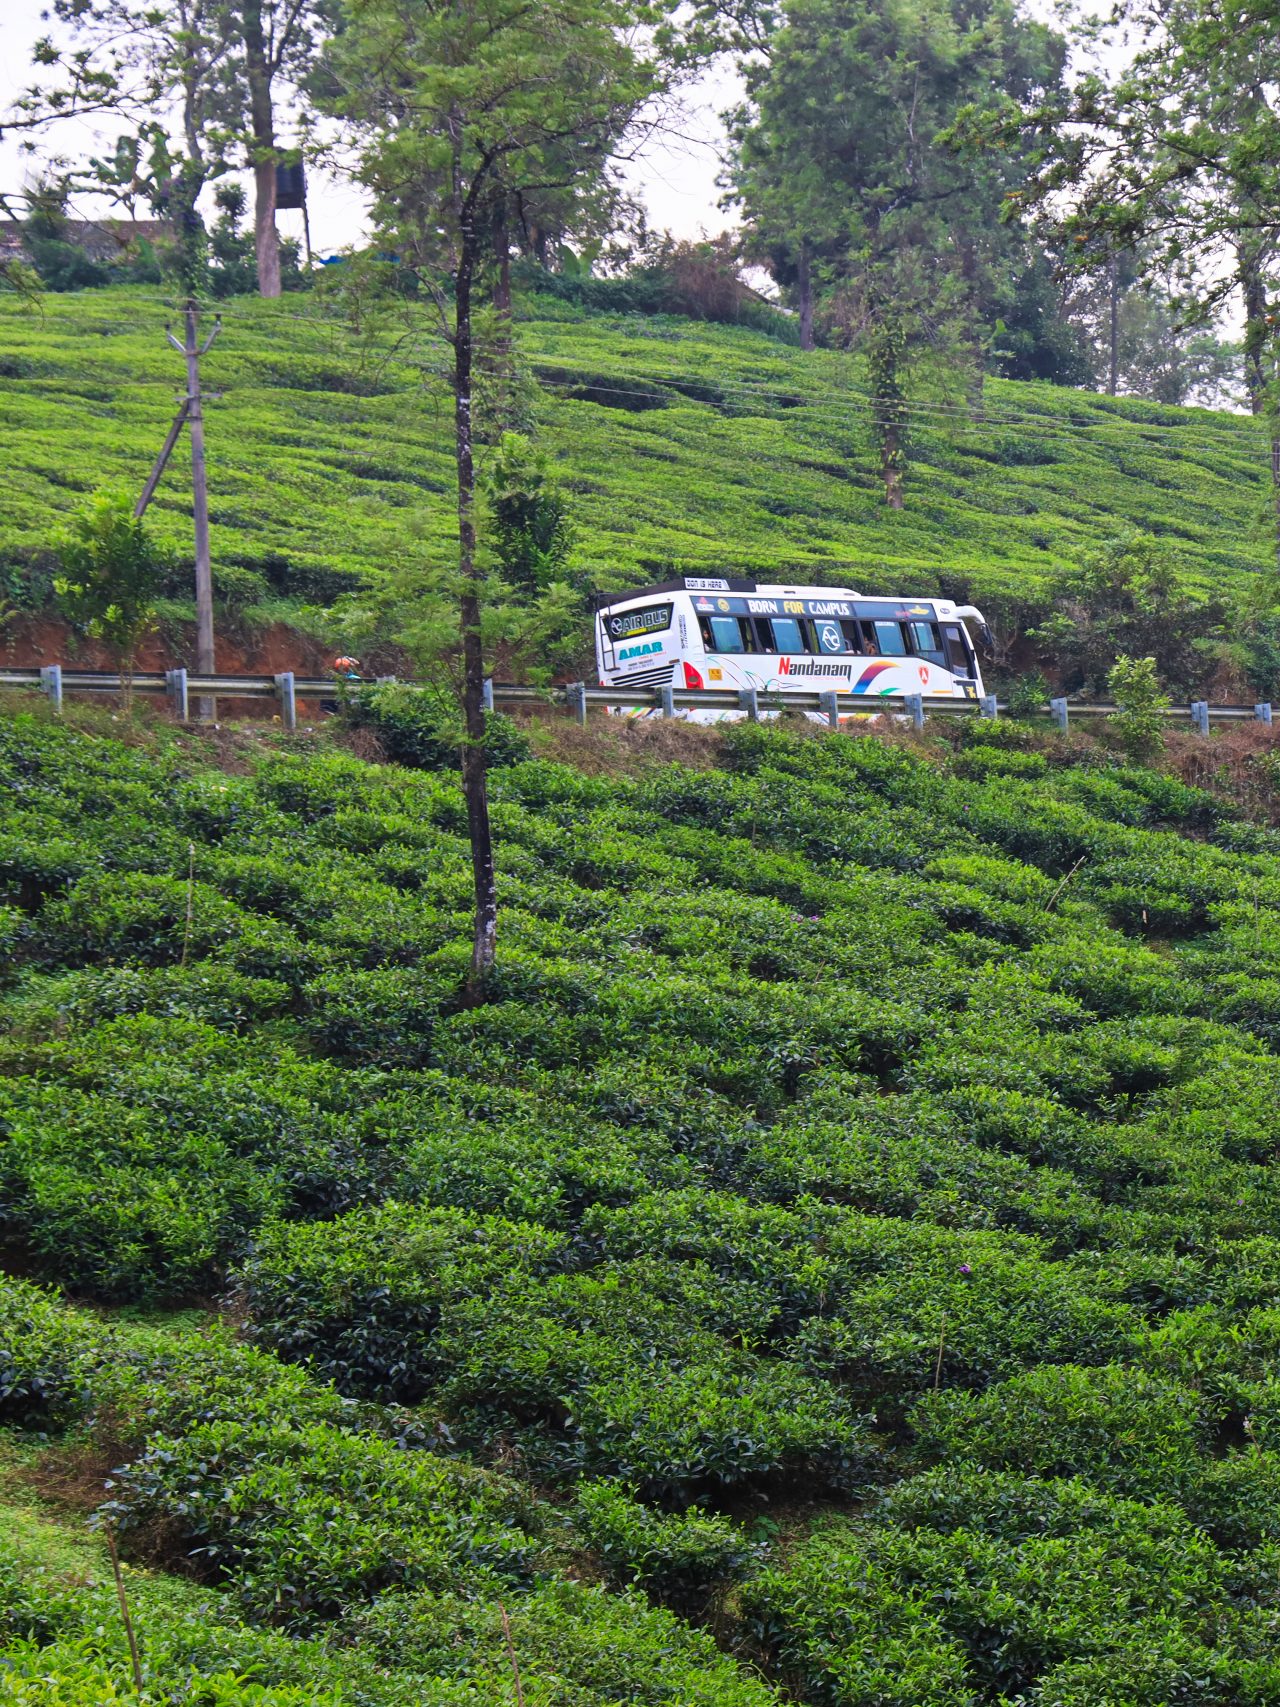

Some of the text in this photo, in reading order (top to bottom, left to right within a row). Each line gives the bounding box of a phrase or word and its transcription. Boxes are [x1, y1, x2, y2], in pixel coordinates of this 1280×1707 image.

[748, 601, 850, 615] BORN FOR CAMPUS
[622, 615, 644, 632] AIR
[644, 610, 668, 627] BUS
[619, 642, 663, 660] AMAR
[779, 657, 852, 682] Nandanam
